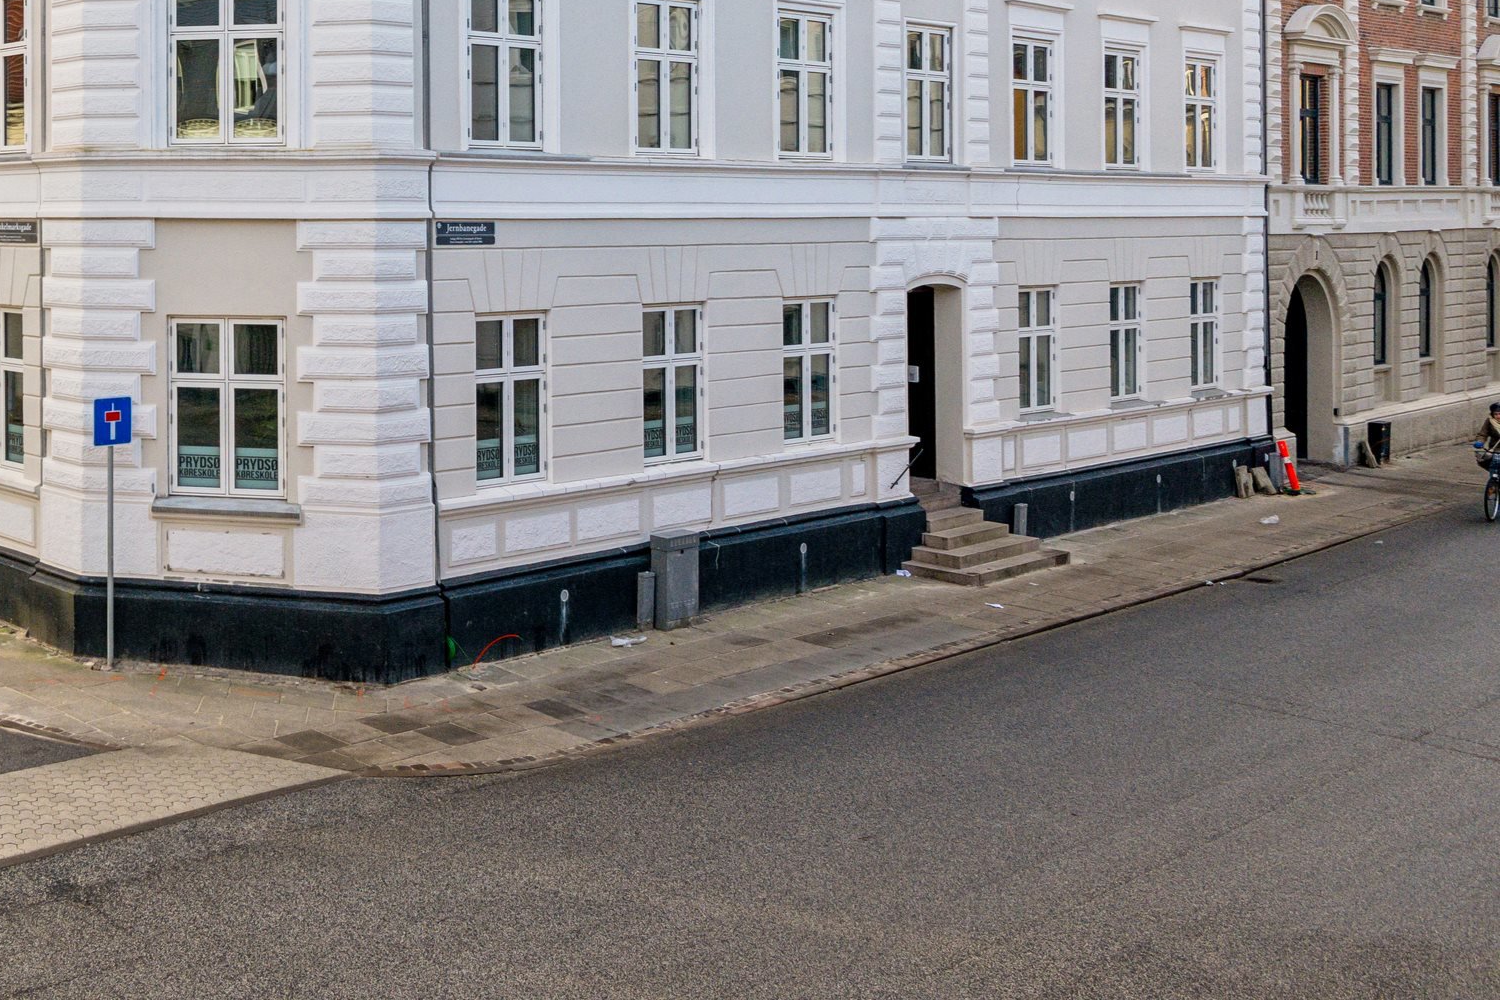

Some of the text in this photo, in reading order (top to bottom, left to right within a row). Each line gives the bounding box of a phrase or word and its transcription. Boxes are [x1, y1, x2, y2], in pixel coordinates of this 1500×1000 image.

[445, 223, 487, 234] Jernbanegade
[180, 456, 220, 469] PRYDSØ
[236, 458, 278, 471] PRYDSØ
[180, 468, 220, 478] KØRESKOLE
[236, 470, 278, 480] KØRESKOLE
